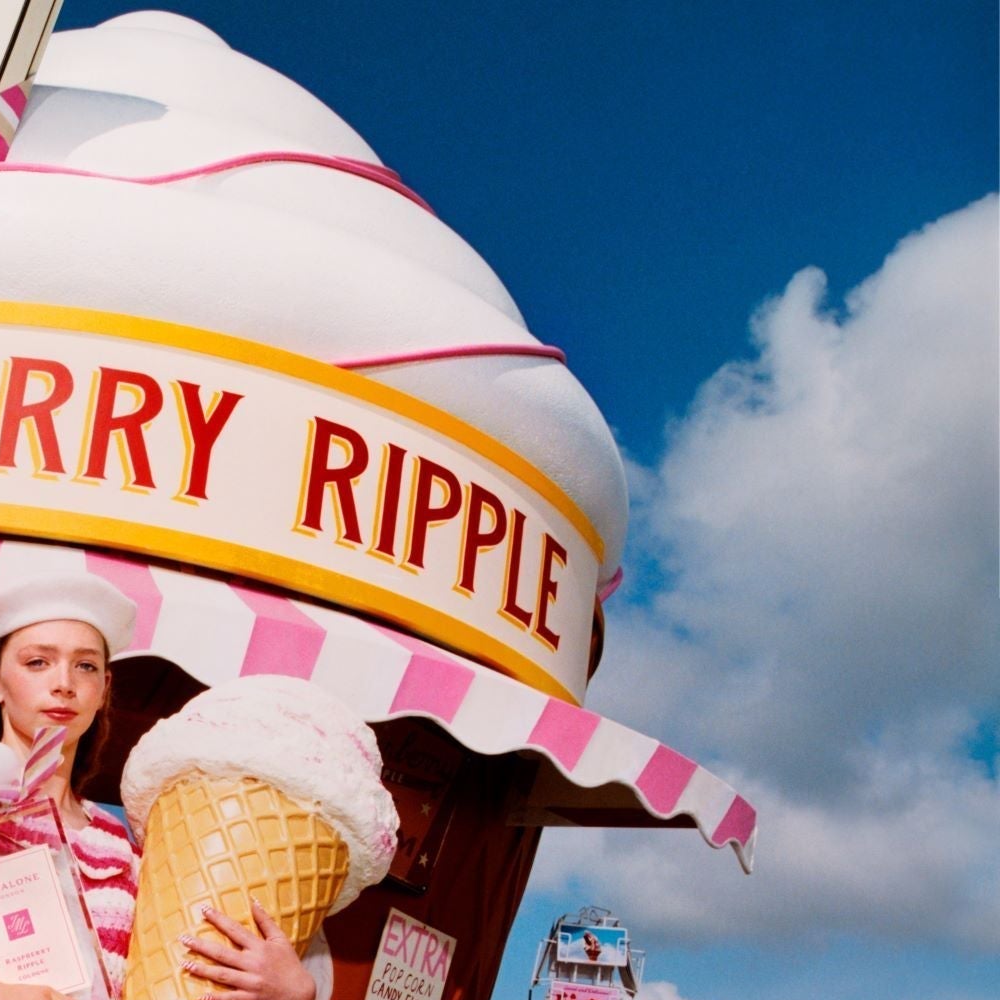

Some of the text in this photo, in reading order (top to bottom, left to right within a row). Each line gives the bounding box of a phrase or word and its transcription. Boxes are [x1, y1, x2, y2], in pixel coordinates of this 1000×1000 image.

[291, 416, 567, 653] RIPPLE
[5, 947, 51, 964] RASPBERRY
[17, 958, 45, 971] RIPPLE
[382, 913, 451, 983] EXTRA
